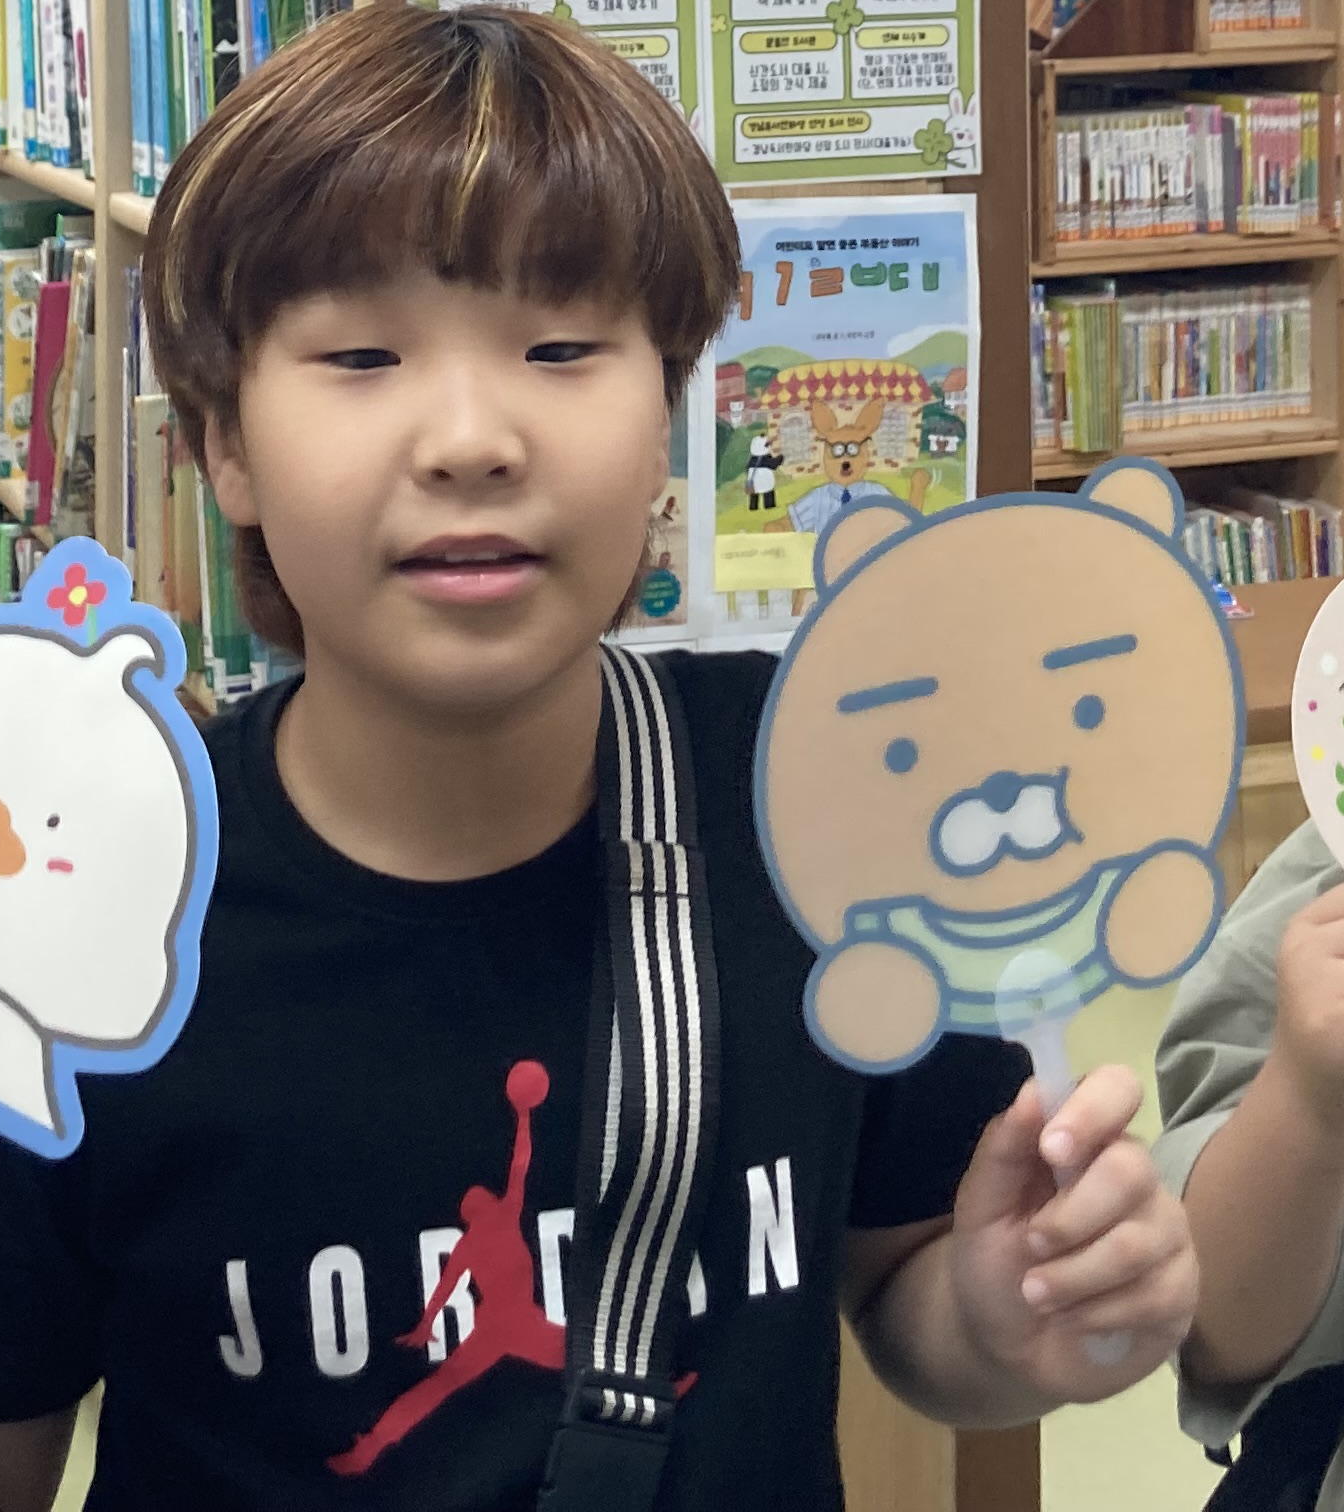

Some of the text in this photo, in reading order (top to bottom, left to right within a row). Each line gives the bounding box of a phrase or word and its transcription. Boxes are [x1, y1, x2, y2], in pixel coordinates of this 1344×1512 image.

[750, 64, 788, 77] 신간도서
[792, 62, 811, 75] 대출
[783, 77, 804, 91] 간식
